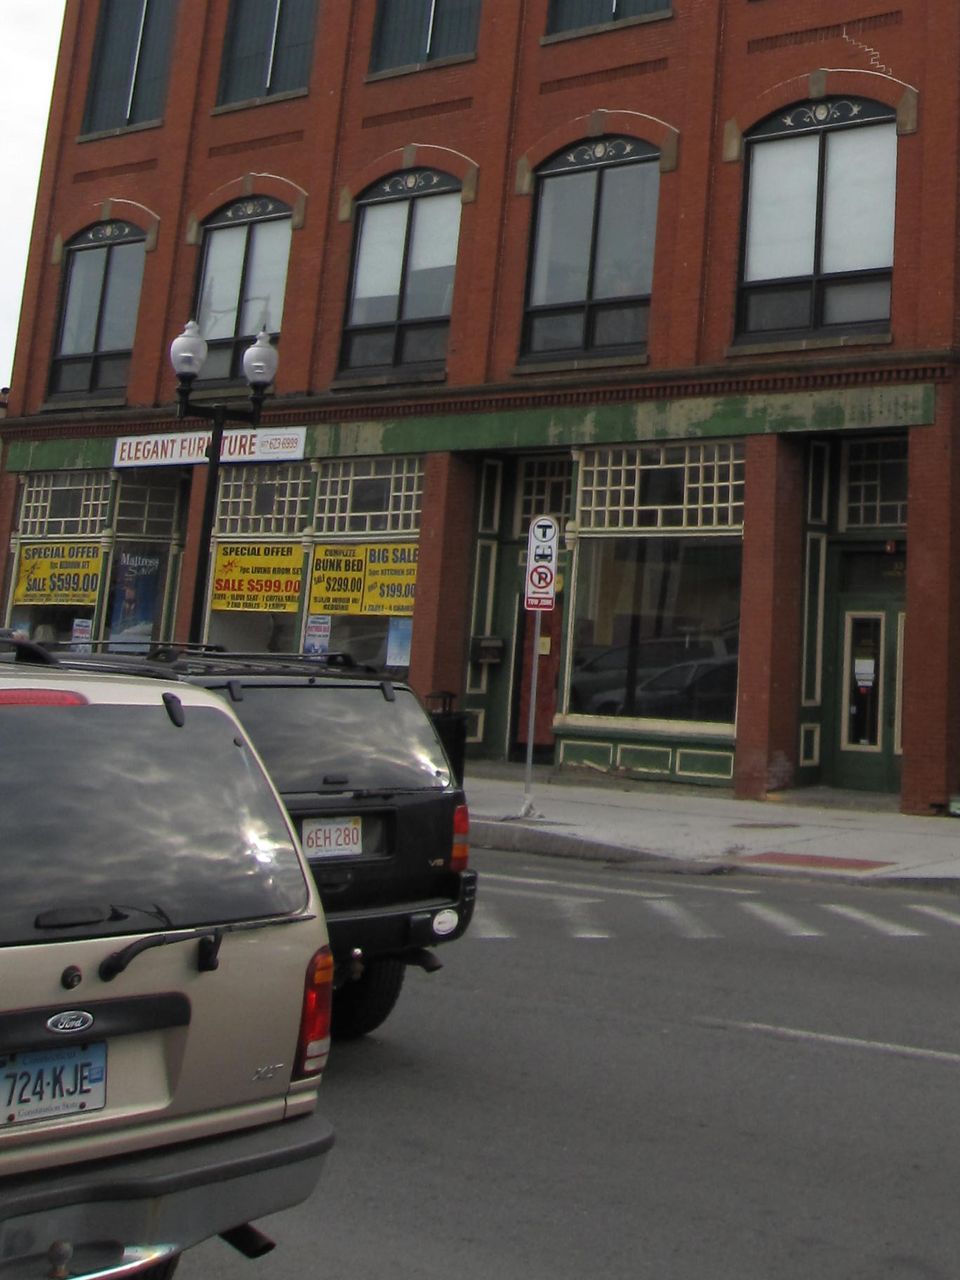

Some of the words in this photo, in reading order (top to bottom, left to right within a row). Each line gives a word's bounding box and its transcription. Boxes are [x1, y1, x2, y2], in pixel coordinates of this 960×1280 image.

[119, 439, 176, 462] ELEGANT
[179, 434, 258, 458] FURTURE
[537, 525, 553, 539] T
[24, 547, 65, 560] SPECIAL
[68, 546, 99, 559] OFFER
[222, 546, 261, 557] SPECIAL
[264, 546, 293, 557] OFFER
[369, 548, 389, 564] BIG
[392, 548, 419, 564] SALE
[315, 558, 342, 572] BUNK
[344, 558, 363, 572] BED
[26, 577, 46, 592] SALE
[49, 572, 98, 593] $599.00
[215, 578, 244, 592] SALE
[247, 578, 301, 593] $599.00
[325, 577, 362, 593] $299.00
[306, 828, 331, 848] 6EH
[335, 826, 359, 846] 280
[58, 1015, 83, 1029] Ford
